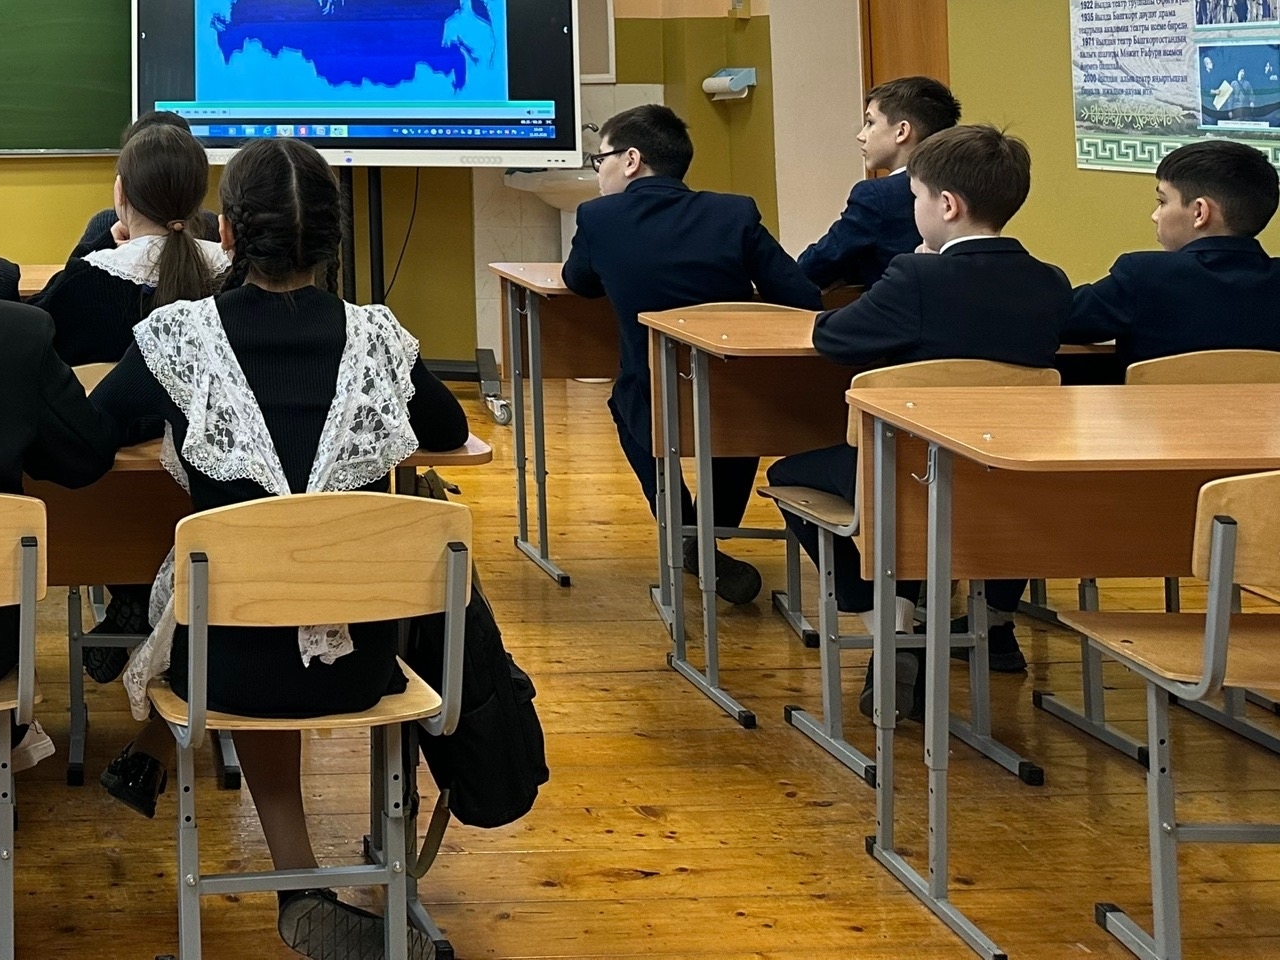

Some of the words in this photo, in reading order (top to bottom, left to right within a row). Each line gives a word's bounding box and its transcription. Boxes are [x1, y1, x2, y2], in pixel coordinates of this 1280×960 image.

[1081, 1, 1093, 10] 1922
[1112, 0, 1127, 9] театр
[1081, 13, 1094, 21] 1935
[1159, 10, 1176, 20] драма
[1130, 23, 1149, 34] театры
[1082, 37, 1095, 46] 1971
[1118, 36, 1132, 46] театр
[1140, 48, 1162, 60] Ғафури
[1083, 74, 1096, 83] 2000
